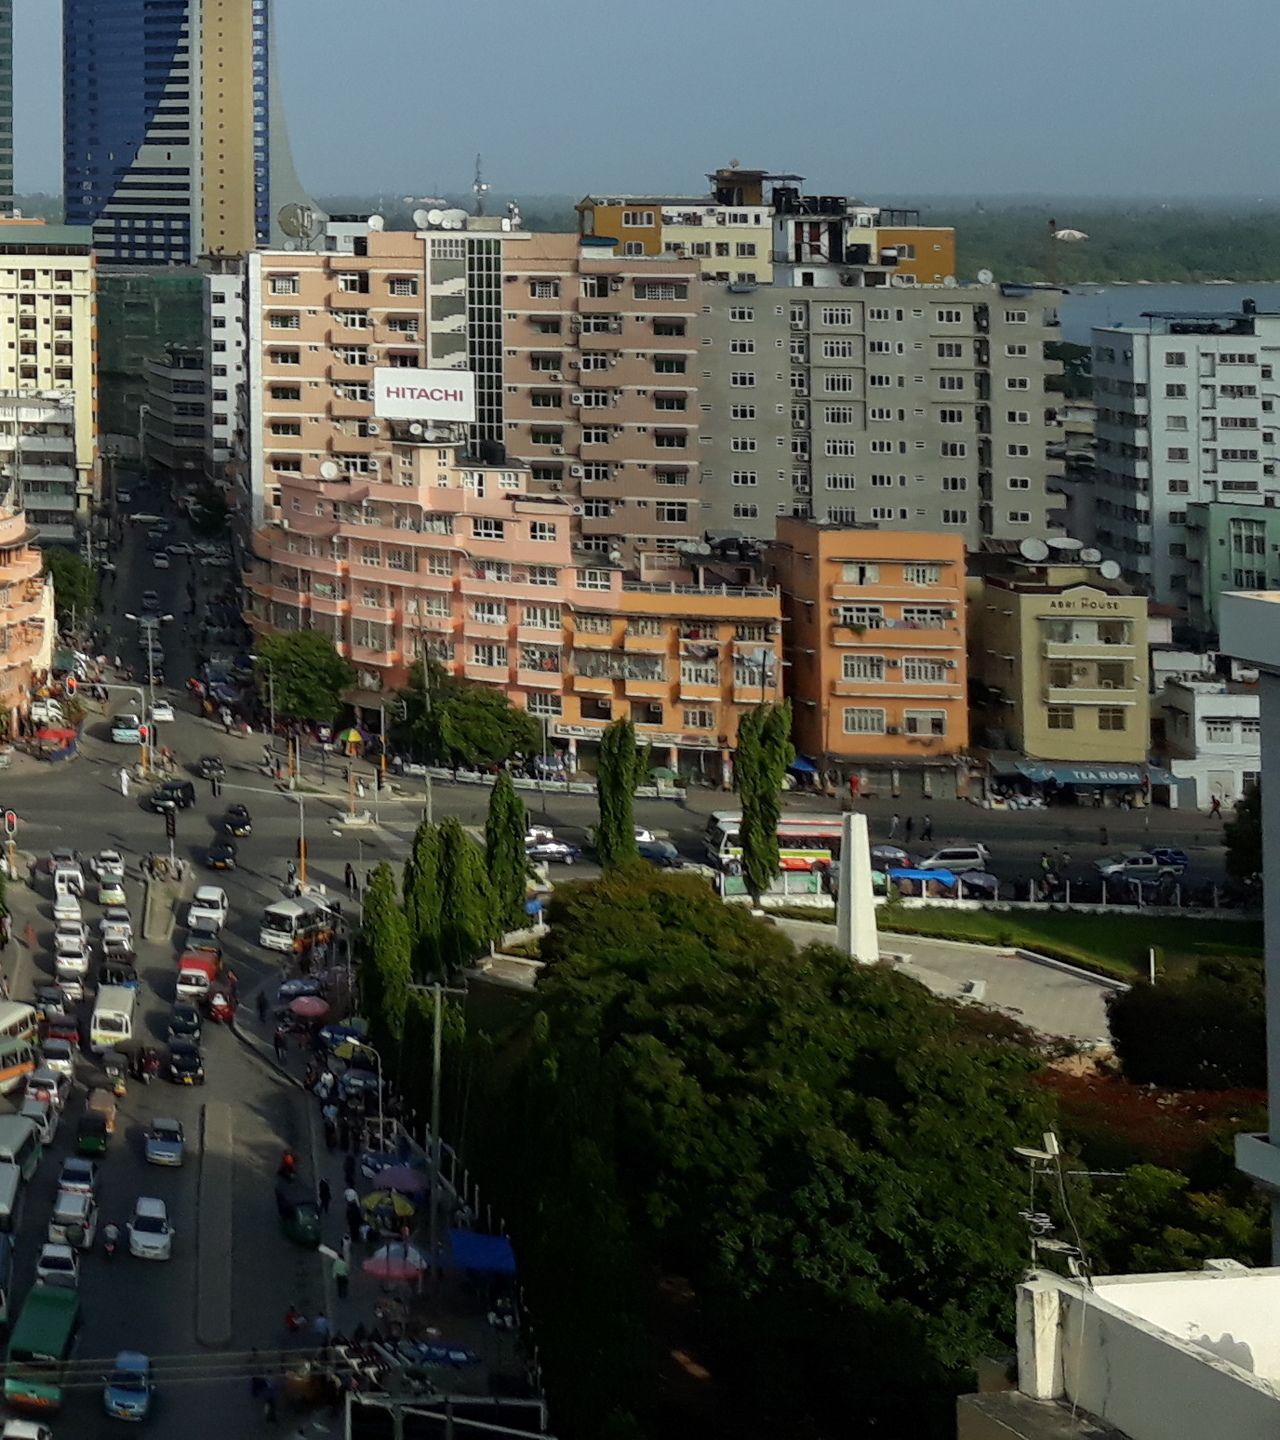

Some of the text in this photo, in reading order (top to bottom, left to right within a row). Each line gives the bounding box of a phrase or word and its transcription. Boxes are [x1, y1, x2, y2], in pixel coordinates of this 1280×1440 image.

[386, 386, 463, 402] HITACHI
[1081, 601, 1119, 610] HOUSE
[1072, 770, 1139, 780] TEA ROOM
